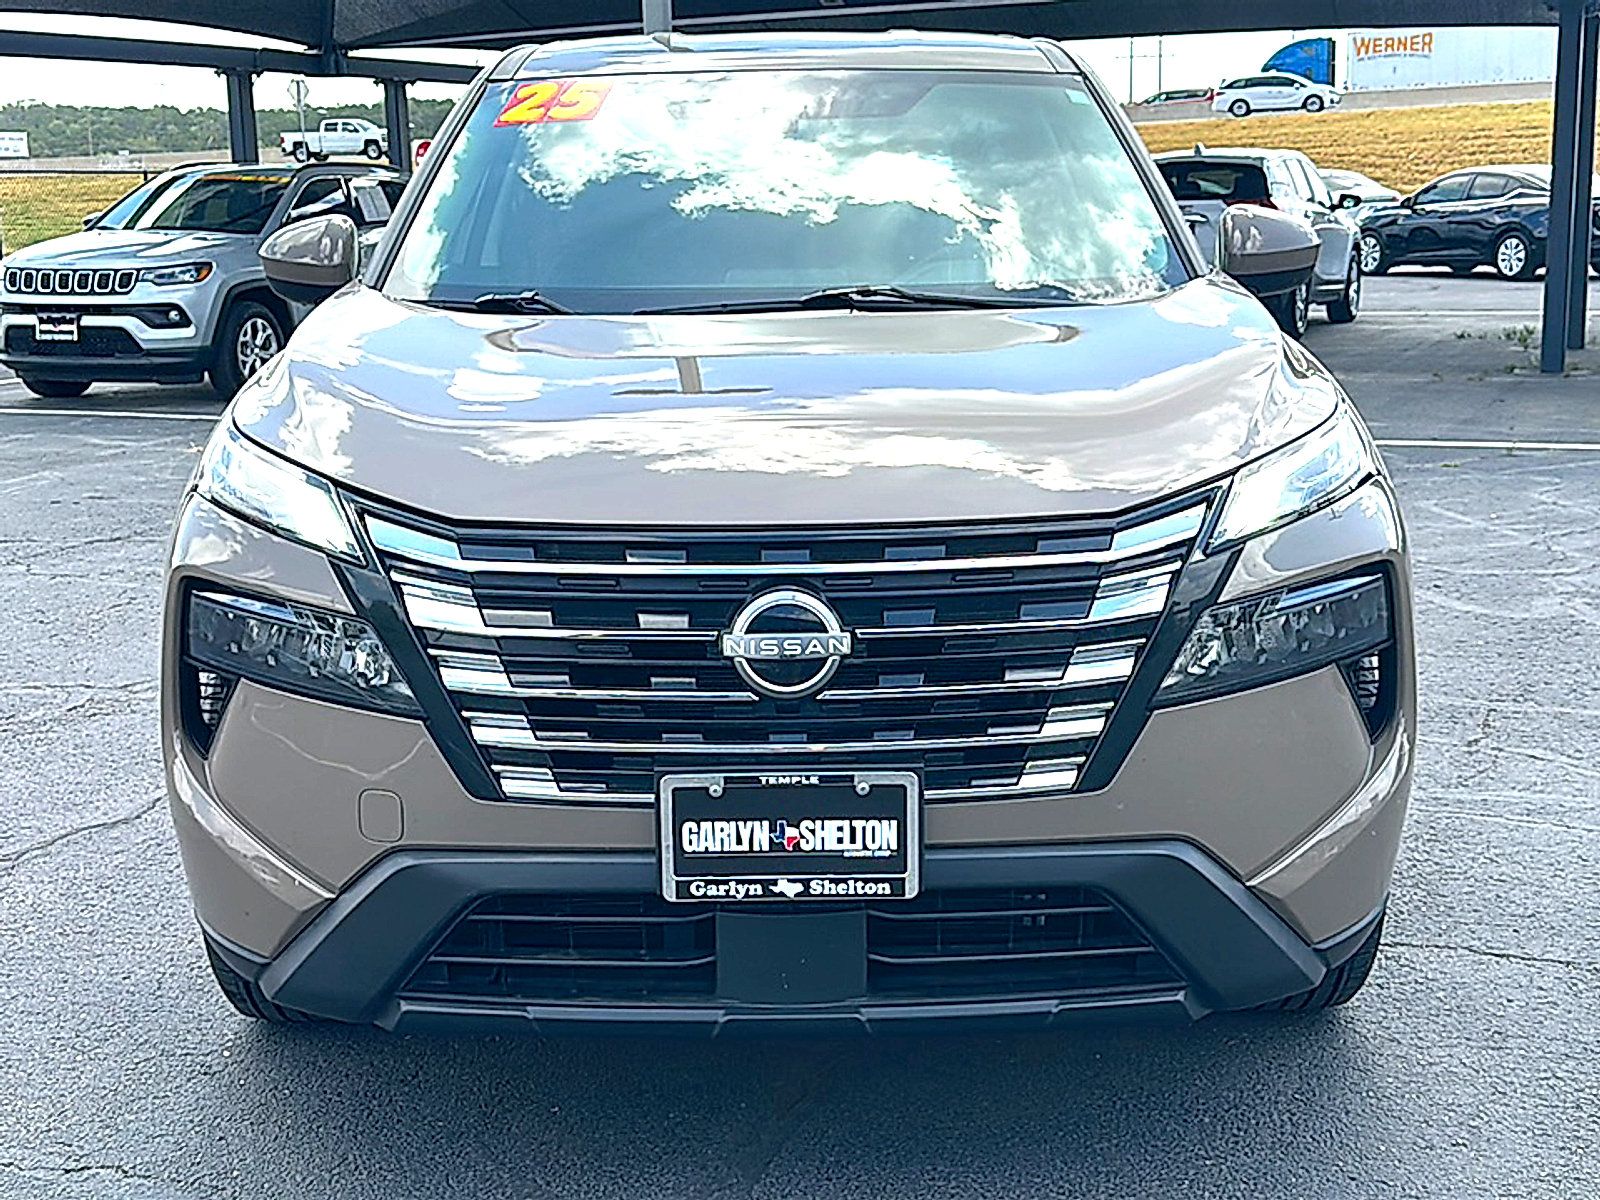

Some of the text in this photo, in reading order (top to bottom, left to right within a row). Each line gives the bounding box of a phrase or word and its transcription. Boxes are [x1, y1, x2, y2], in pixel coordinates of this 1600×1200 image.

[1352, 32, 1433, 56] WERNER
[499, 80, 612, 122] 25
[725, 637, 848, 655] NISSAN
[759, 776, 820, 785] TEMPLE
[682, 819, 898, 852] GARLYN SHELTON
[689, 879, 891, 899] Garlyn Shelton
